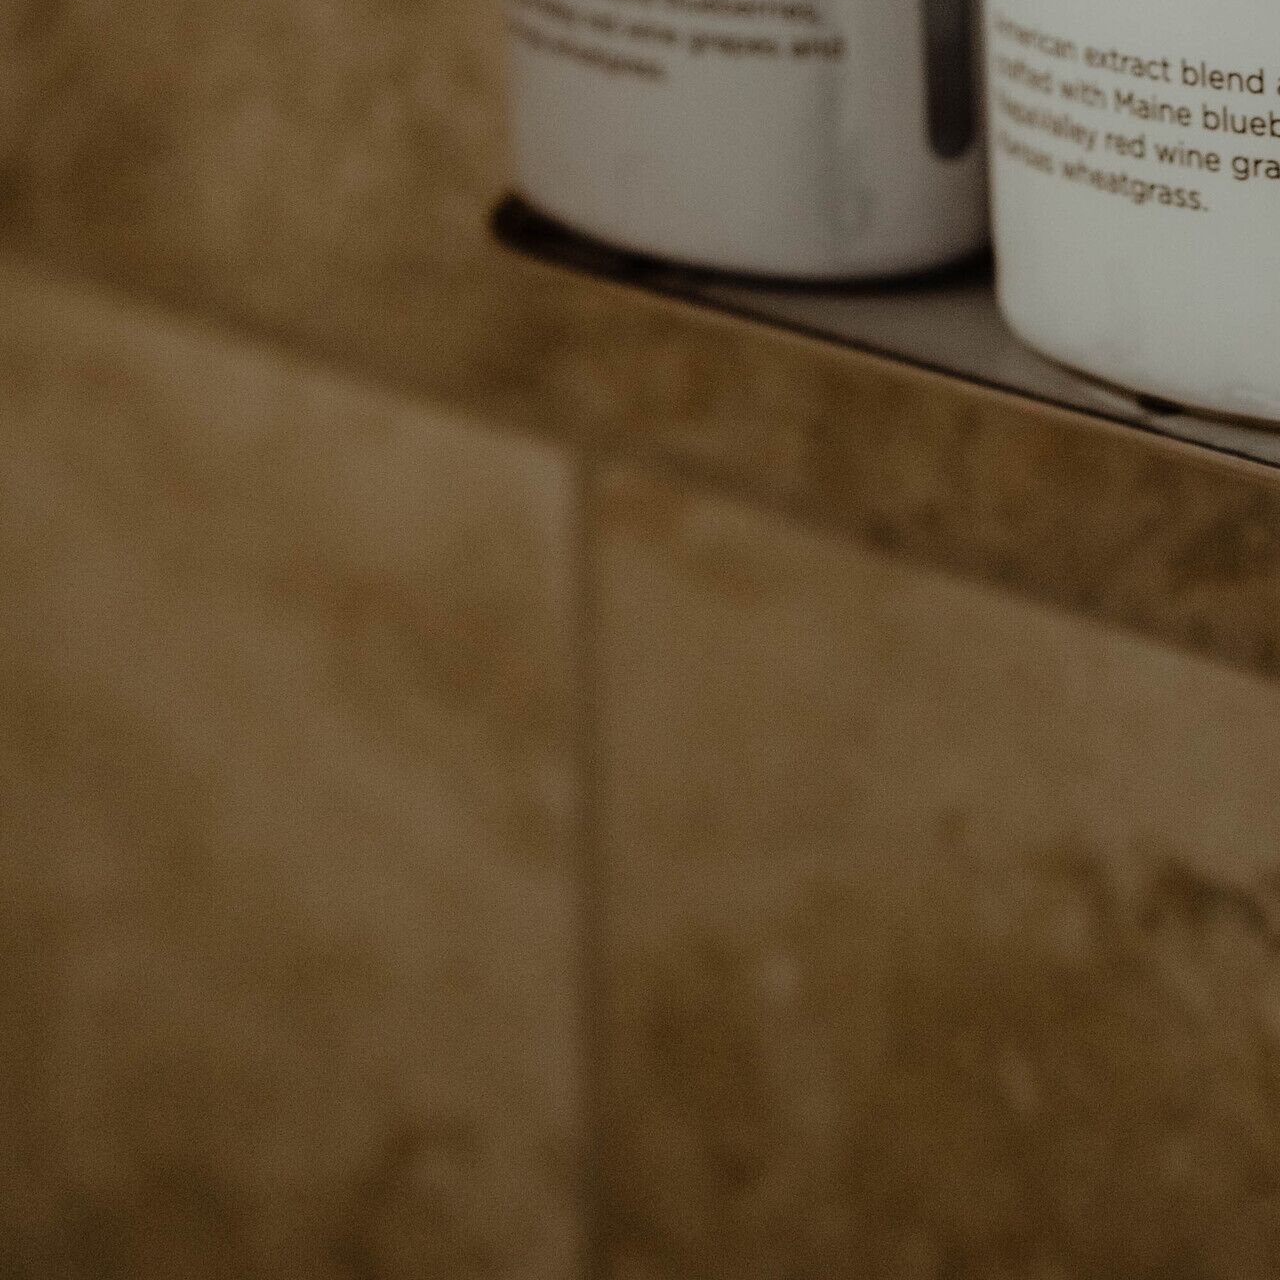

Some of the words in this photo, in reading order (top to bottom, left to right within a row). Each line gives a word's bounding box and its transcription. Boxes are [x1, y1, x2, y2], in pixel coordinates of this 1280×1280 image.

[1084, 46, 1169, 83] extract
[1181, 58, 1265, 94] blend
[1114, 88, 1191, 127] Maine
[1155, 141, 1220, 172] wine
